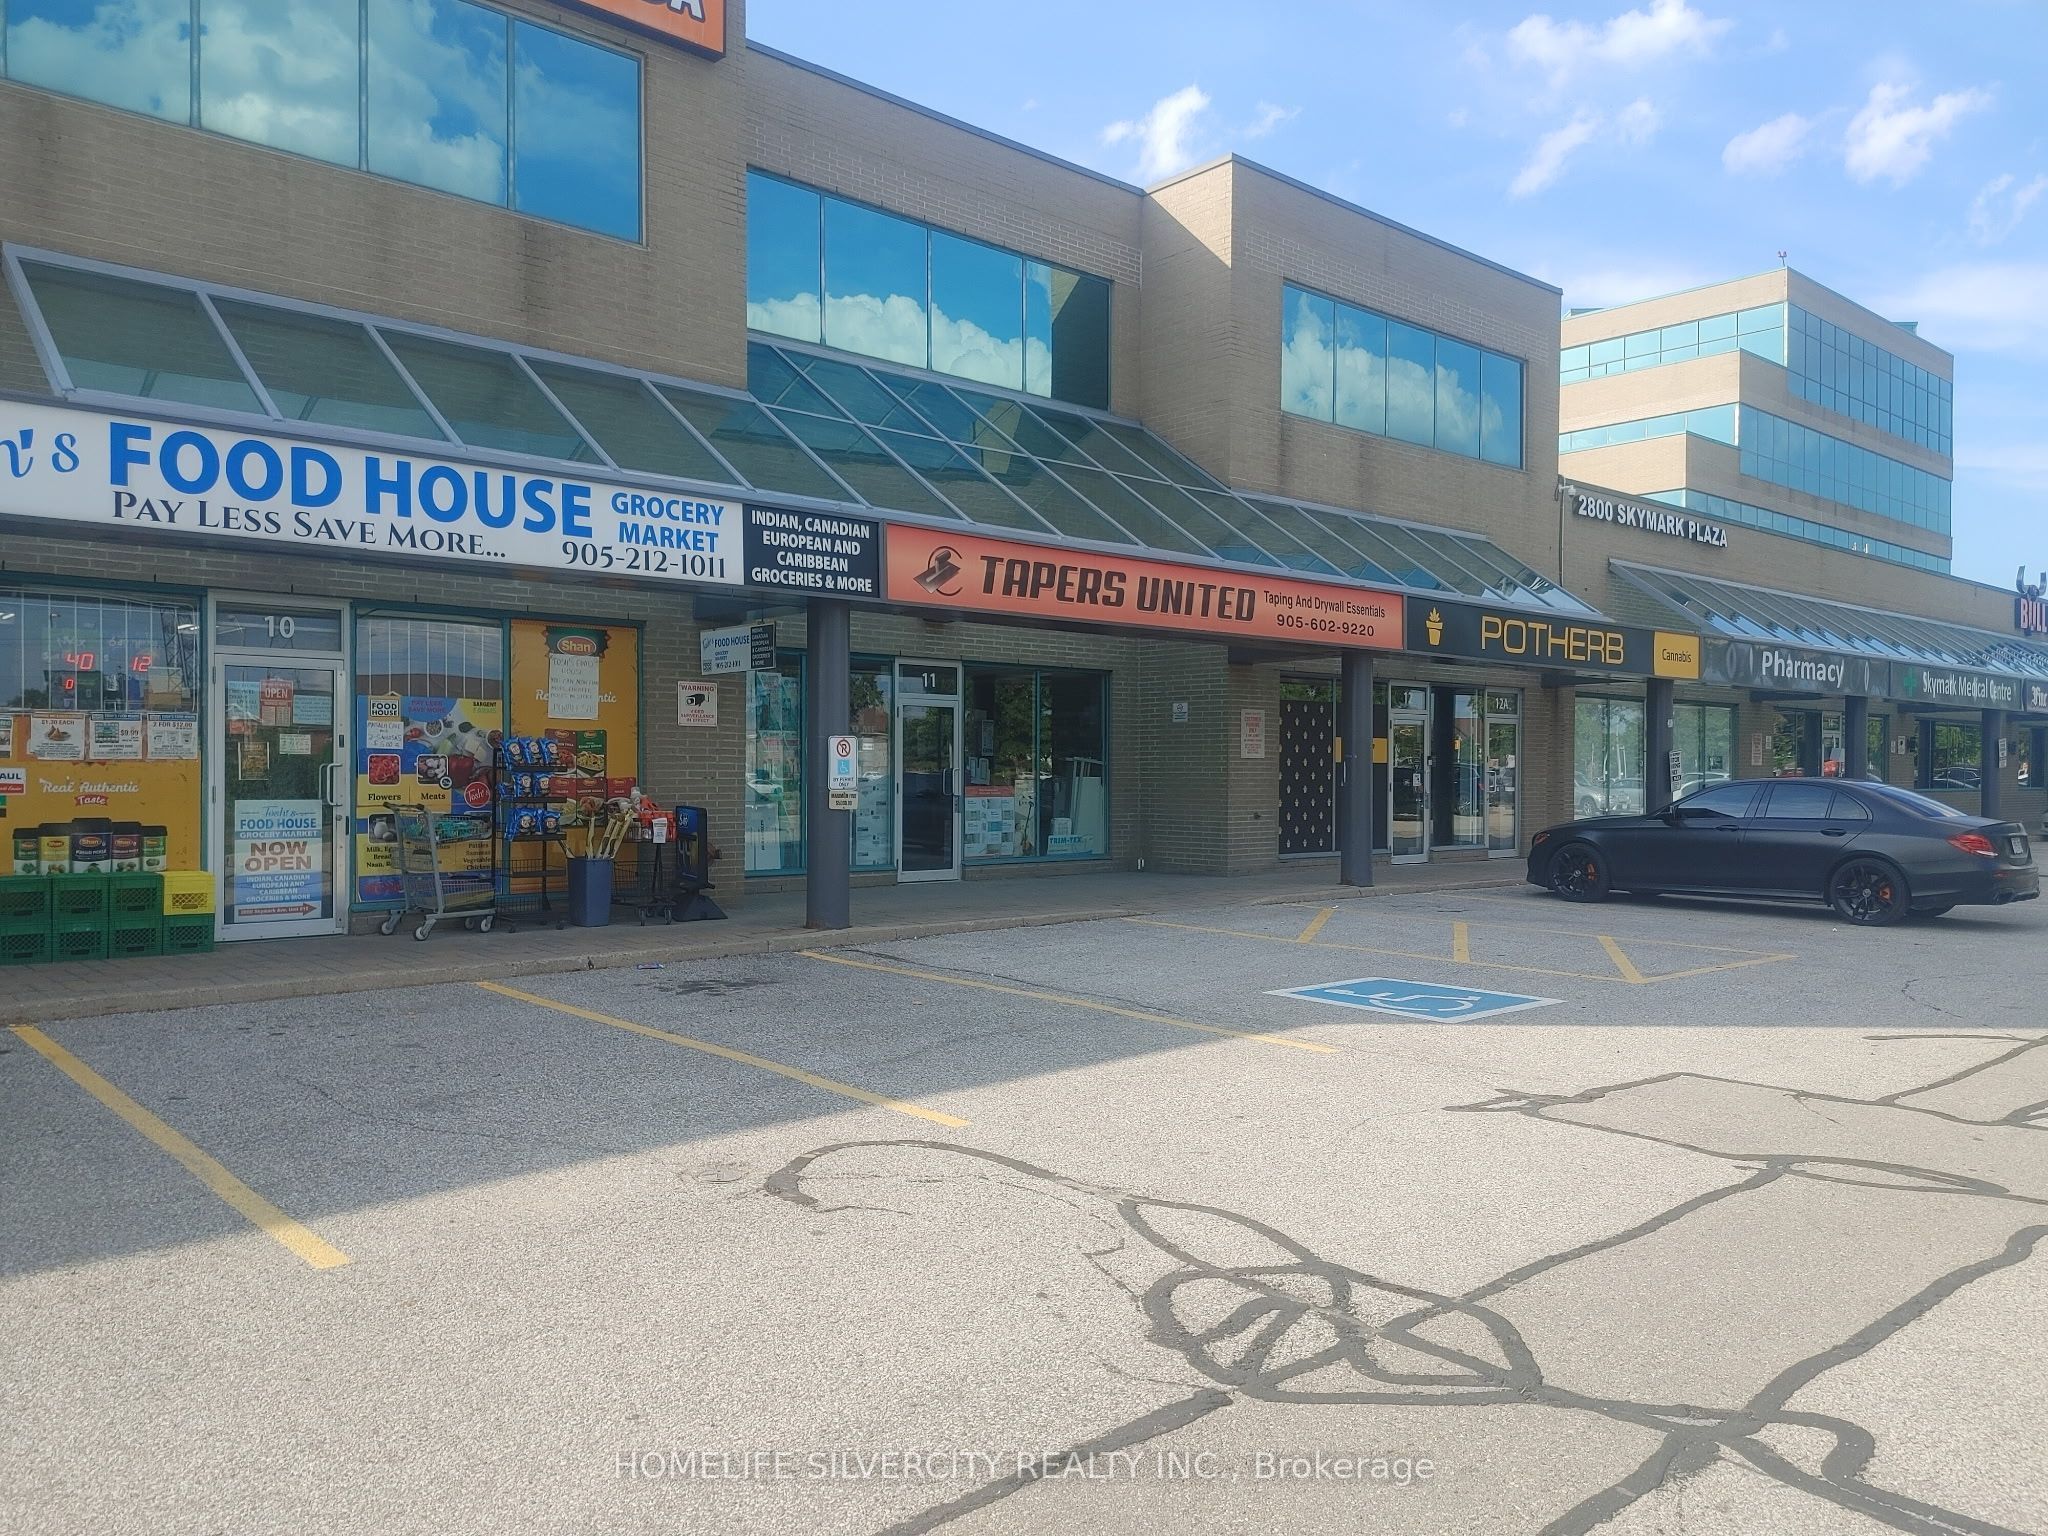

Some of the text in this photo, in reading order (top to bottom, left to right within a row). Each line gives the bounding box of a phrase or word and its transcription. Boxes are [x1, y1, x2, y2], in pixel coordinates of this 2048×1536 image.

[110, 421, 342, 508] FOOD
[365, 456, 593, 538] HOUSE
[112, 490, 184, 525] PAY
[198, 500, 281, 535] LESS
[293, 511, 376, 544] SAVE
[611, 492, 724, 526] GROCERY
[751, 510, 870, 539] INDIAN, CANADIAN
[1578, 494, 1728, 548] 2800 SKYMARK PLAZA
[618, 521, 719, 553] MARKET
[762, 530, 861, 555] EUROPEAN AND
[562, 541, 726, 578] 905-212-1011
[776, 551, 848, 572] CARIBBEAN
[751, 567, 872, 593] GROCERIES & MORE
[980, 555, 1256, 622] TAPERS UNITED
[1263, 590, 1386, 618] Taping And Drywall Essentials
[1276, 614, 1375, 637] 905-602-9220
[2020, 597, 2048, 633] BULL
[264, 616, 295, 639] 10
[561, 640, 591, 653] Shan
[714, 634, 750, 649] FOOD HOUSE
[1481, 615, 1625, 665] POTHERB
[132, 655, 152, 672] 12
[1661, 648, 1692, 663] Cannabis
[922, 672, 936, 688] 11
[1761, 650, 1845, 689] Pharmacy
[65, 678, 74, 690] 0
[265, 688, 289, 698] OPEN
[681, 684, 714, 692] WARNING
[1922, 671, 2012, 702] Skymark Medical Centre
[371, 702, 397, 710] FOOD
[39, 776, 74, 793] Real
[79, 780, 139, 793] Authentic
[77, 794, 106, 805] Taste
[368, 793, 402, 801] Flowers
[421, 792, 446, 800] Meats
[239, 830, 317, 839] GROCERY MARKET
[240, 818, 317, 830] FOOD HOUSE
[250, 841, 308, 857] NOW
[245, 856, 312, 872] OPEN
